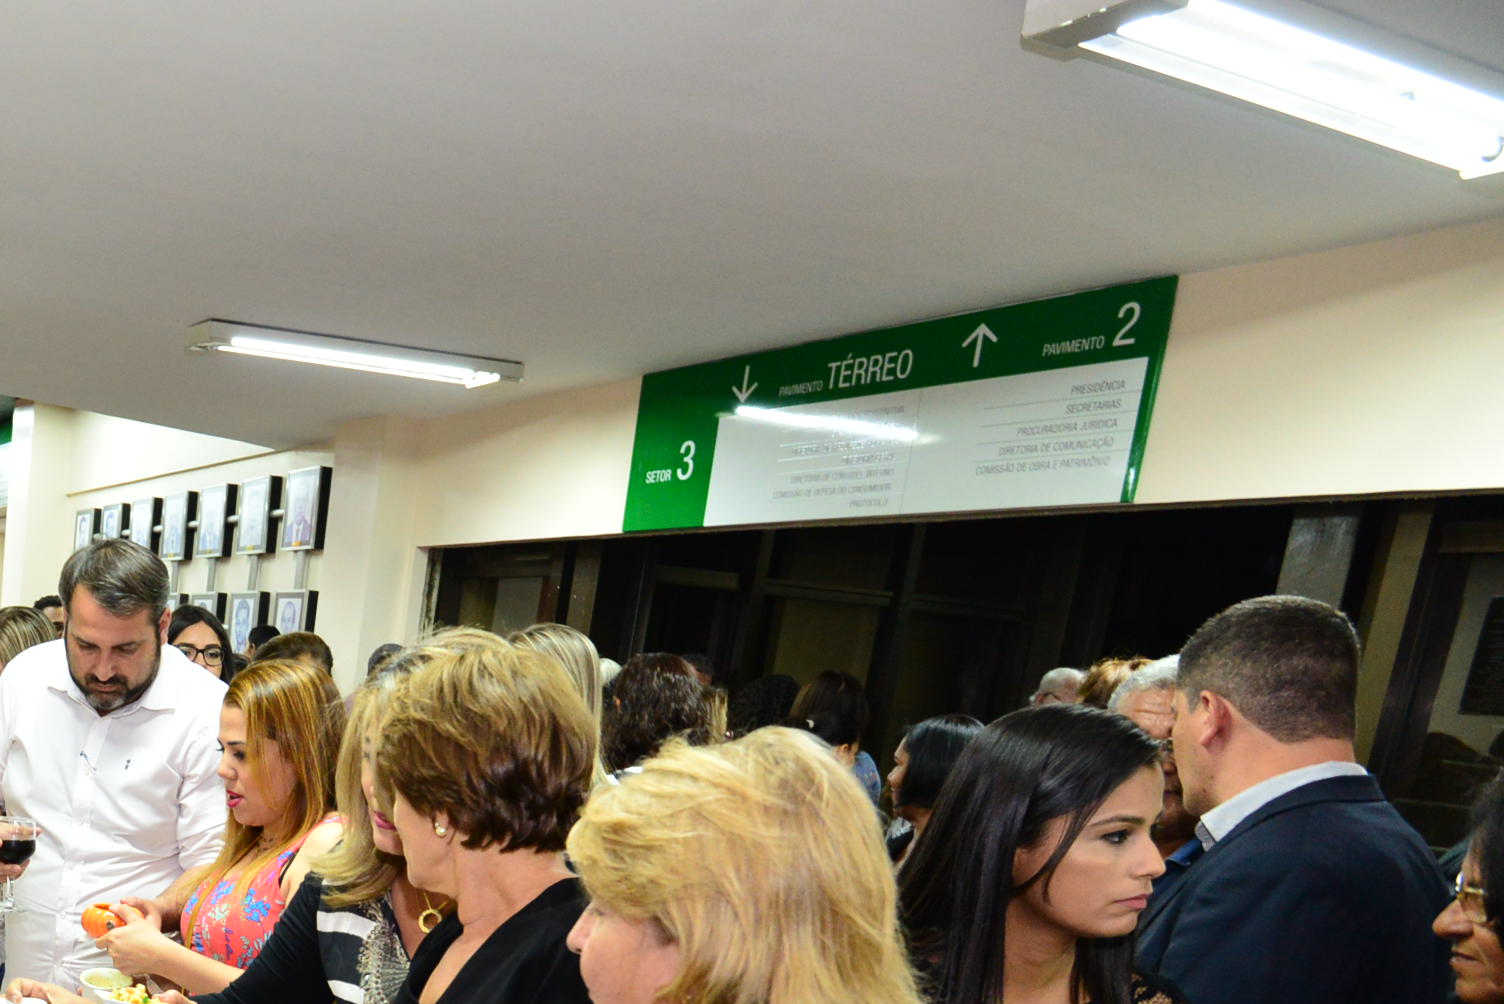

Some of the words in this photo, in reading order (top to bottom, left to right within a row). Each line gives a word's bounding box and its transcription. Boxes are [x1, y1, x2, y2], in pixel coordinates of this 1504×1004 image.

[1042, 335, 1105, 357] PAVIMENTO
[1112, 301, 1141, 347] 2
[779, 380, 823, 397] PAVIMENTO
[828, 349, 913, 389] TÉRREO
[1070, 379, 1126, 395] PRESIDÊNCIA
[1065, 398, 1122, 415] SECRETARIAS
[1040, 443, 1051, 453] DE
[645, 469, 672, 484] SETOR
[676, 440, 696, 481] 3
[1016, 461, 1027, 473] DE
